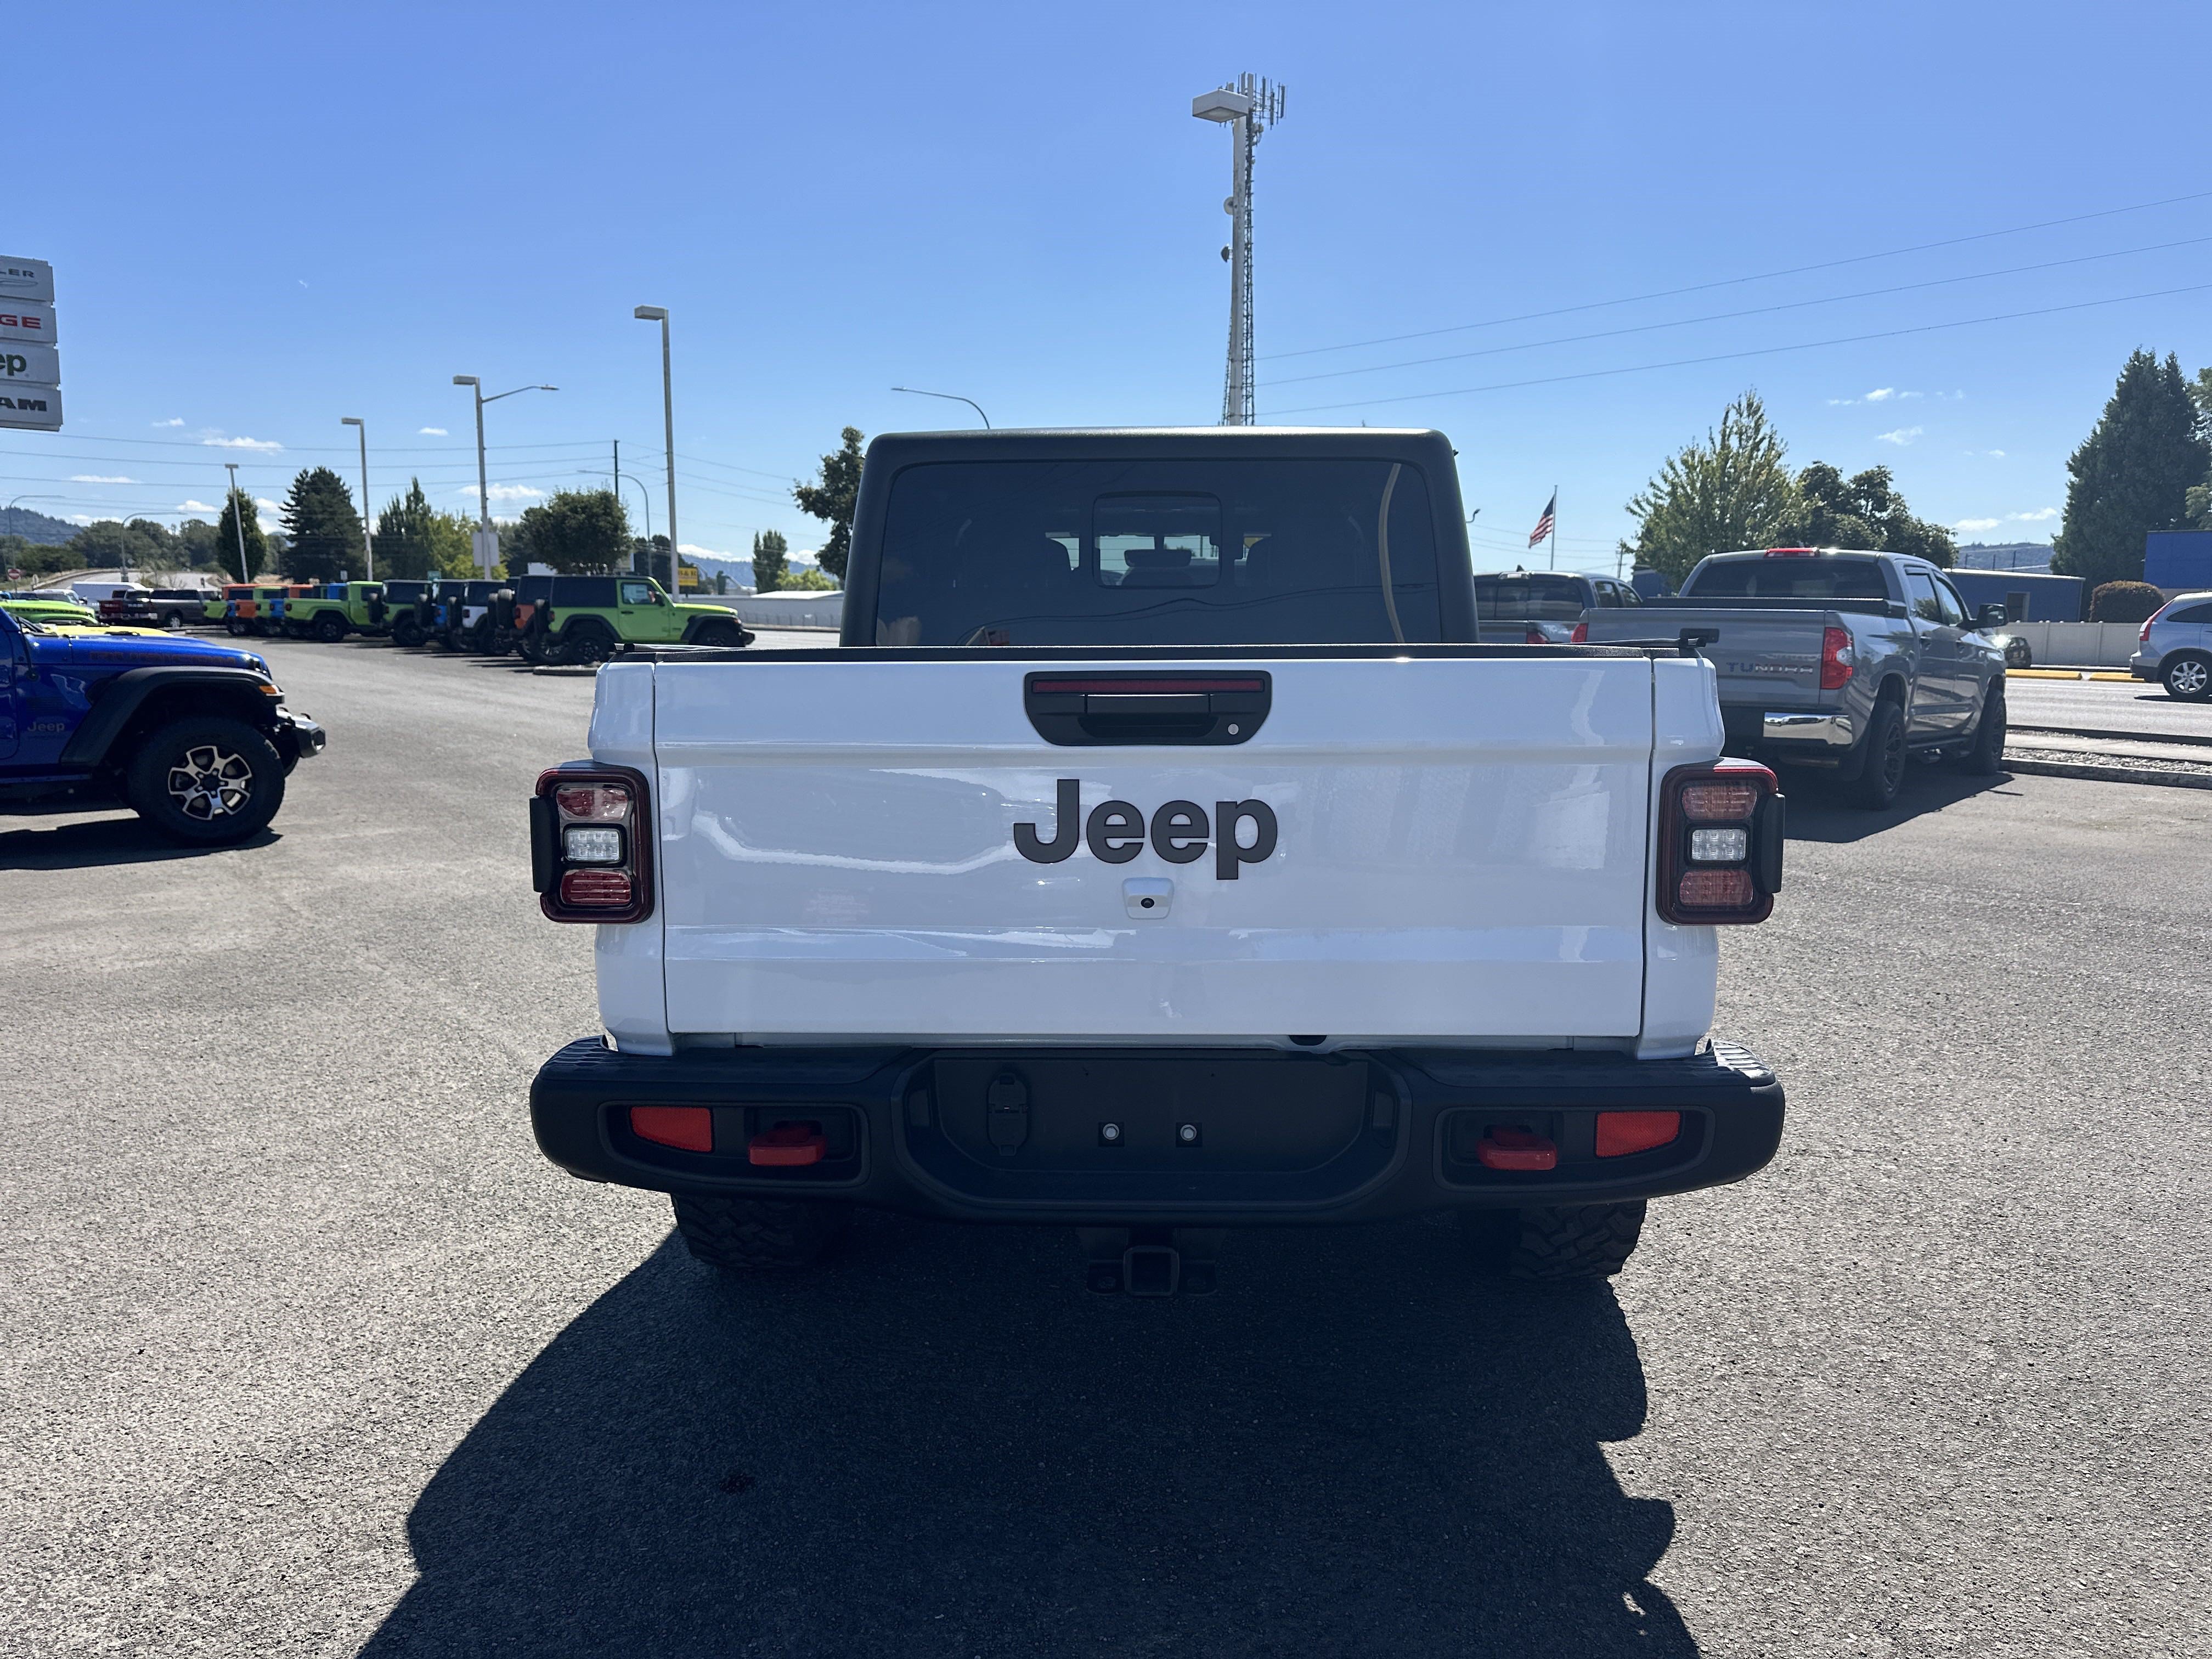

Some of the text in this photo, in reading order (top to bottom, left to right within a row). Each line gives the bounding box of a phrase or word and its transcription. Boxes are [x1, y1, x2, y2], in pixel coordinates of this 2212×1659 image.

[1726, 662, 1814, 674] TUNDRA
[27, 721, 65, 733] Jeep
[1013, 778, 1278, 881] Jeep
